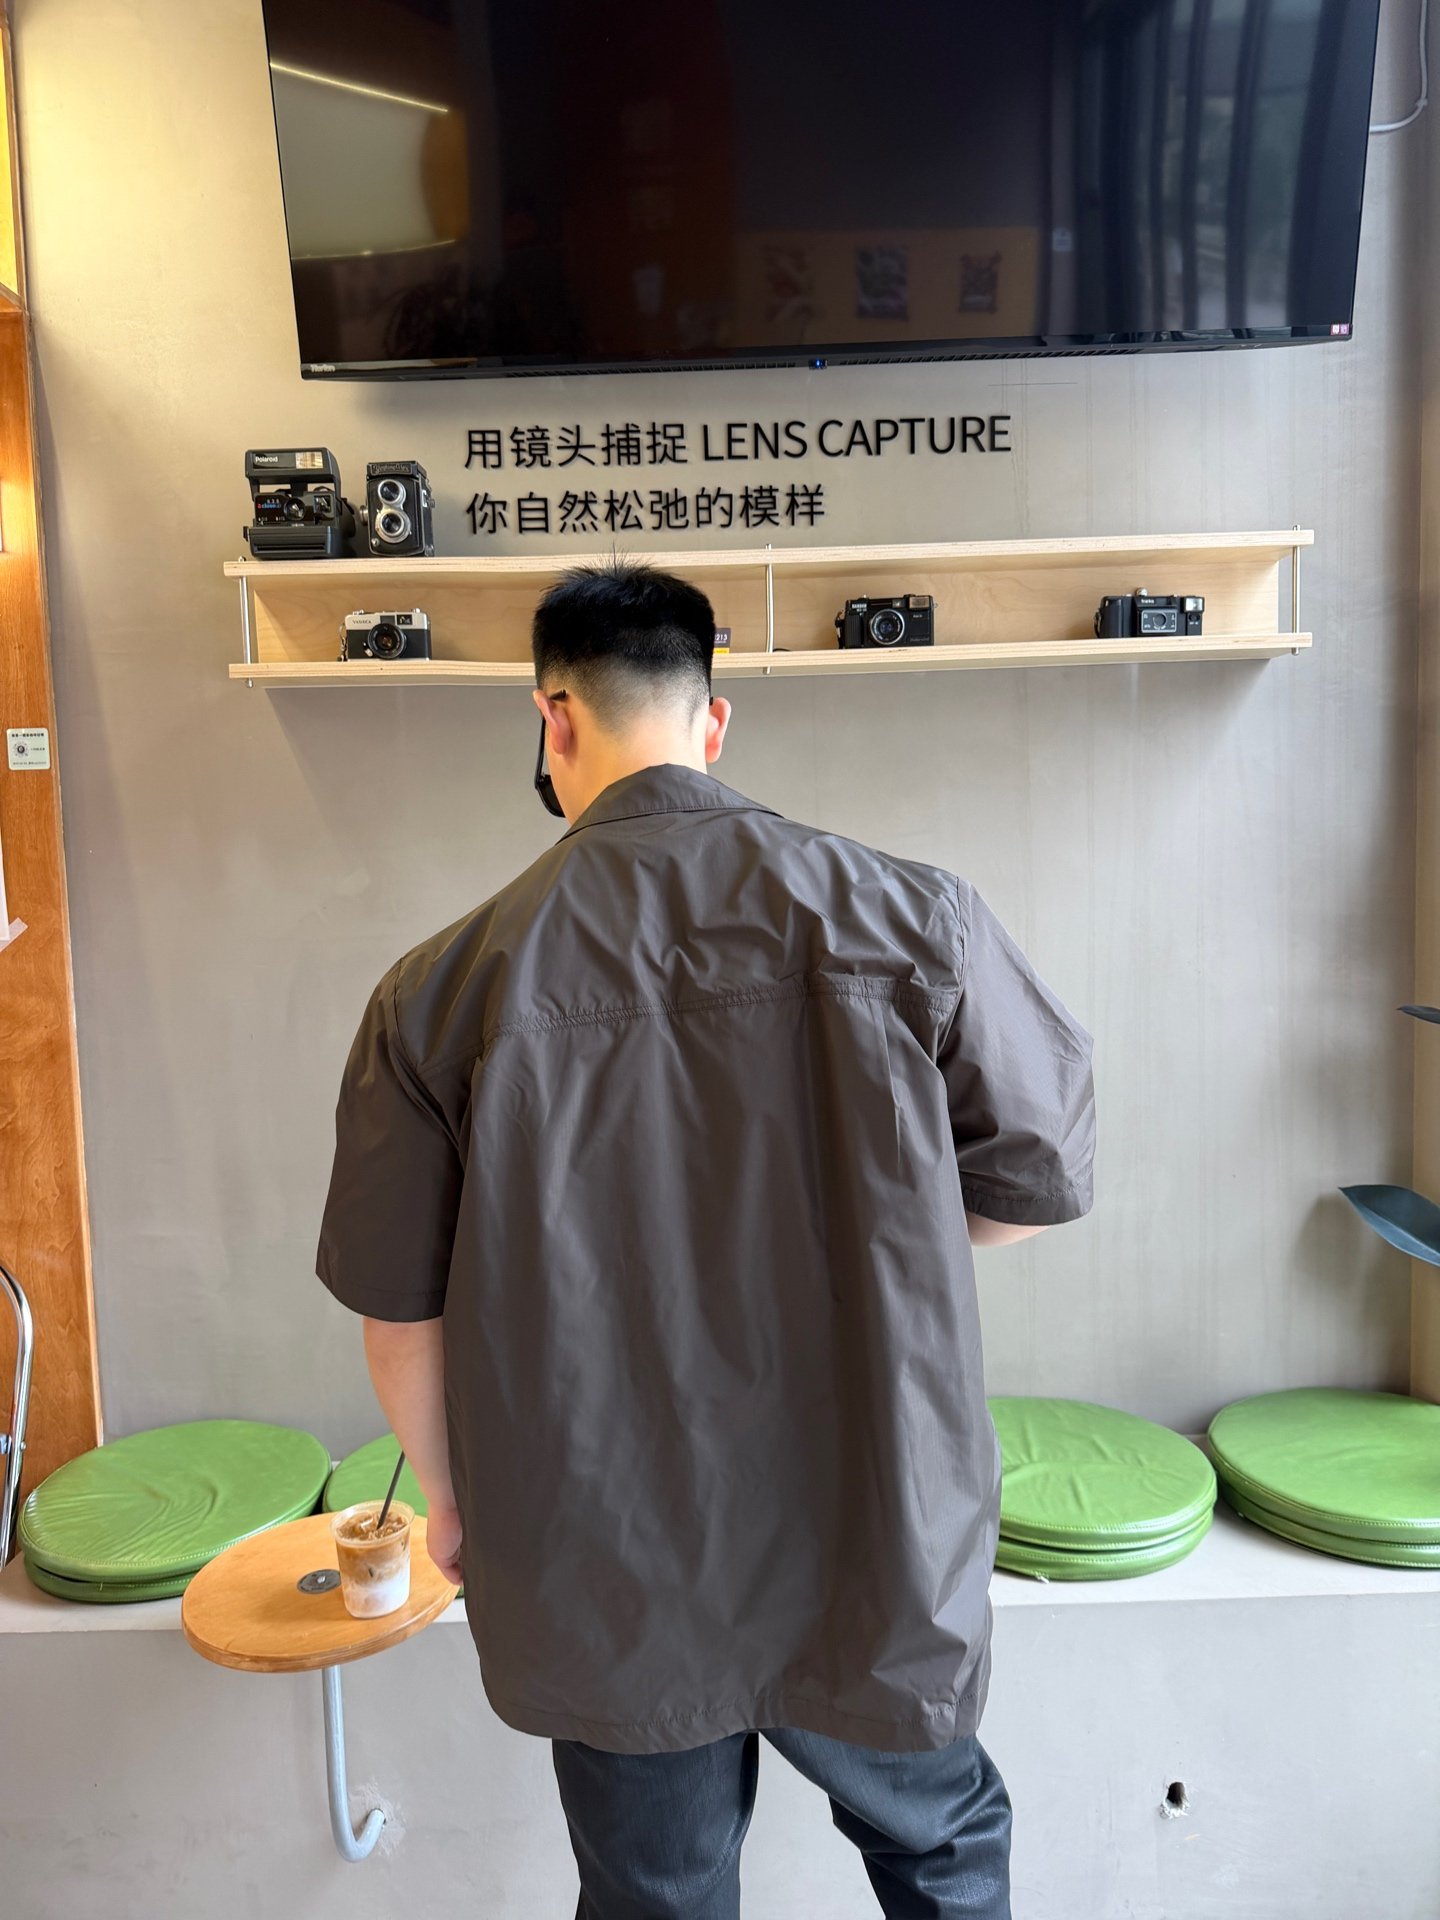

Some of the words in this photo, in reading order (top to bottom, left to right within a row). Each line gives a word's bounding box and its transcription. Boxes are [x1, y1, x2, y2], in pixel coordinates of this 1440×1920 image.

[464, 422, 688, 469] 用镜头捕捉
[702, 420, 808, 461] LENS
[817, 415, 1012, 457] CAPTURE
[465, 483, 826, 535] 你自然松弛的模样
